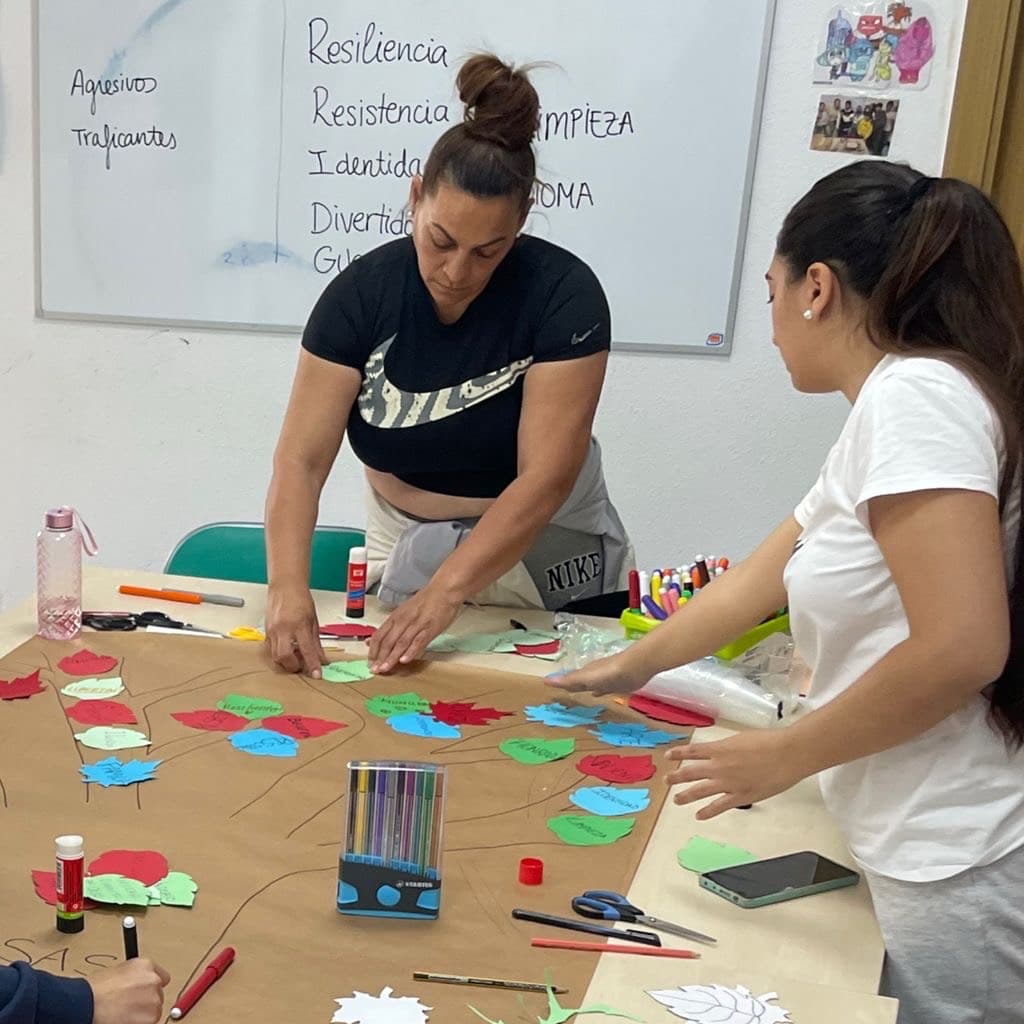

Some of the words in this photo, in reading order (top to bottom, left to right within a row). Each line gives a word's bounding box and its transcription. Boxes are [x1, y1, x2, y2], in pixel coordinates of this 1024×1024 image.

[308, 18, 449, 67] Resiliencia
[71, 70, 158, 114] Agresivos
[312, 86, 450, 128] Resistencia
[536, 102, 634, 141] IMPIEZA
[72, 126, 178, 169] Traficantes
[308, 148, 424, 178] Identida
[545, 551, 602, 592] NIKE
